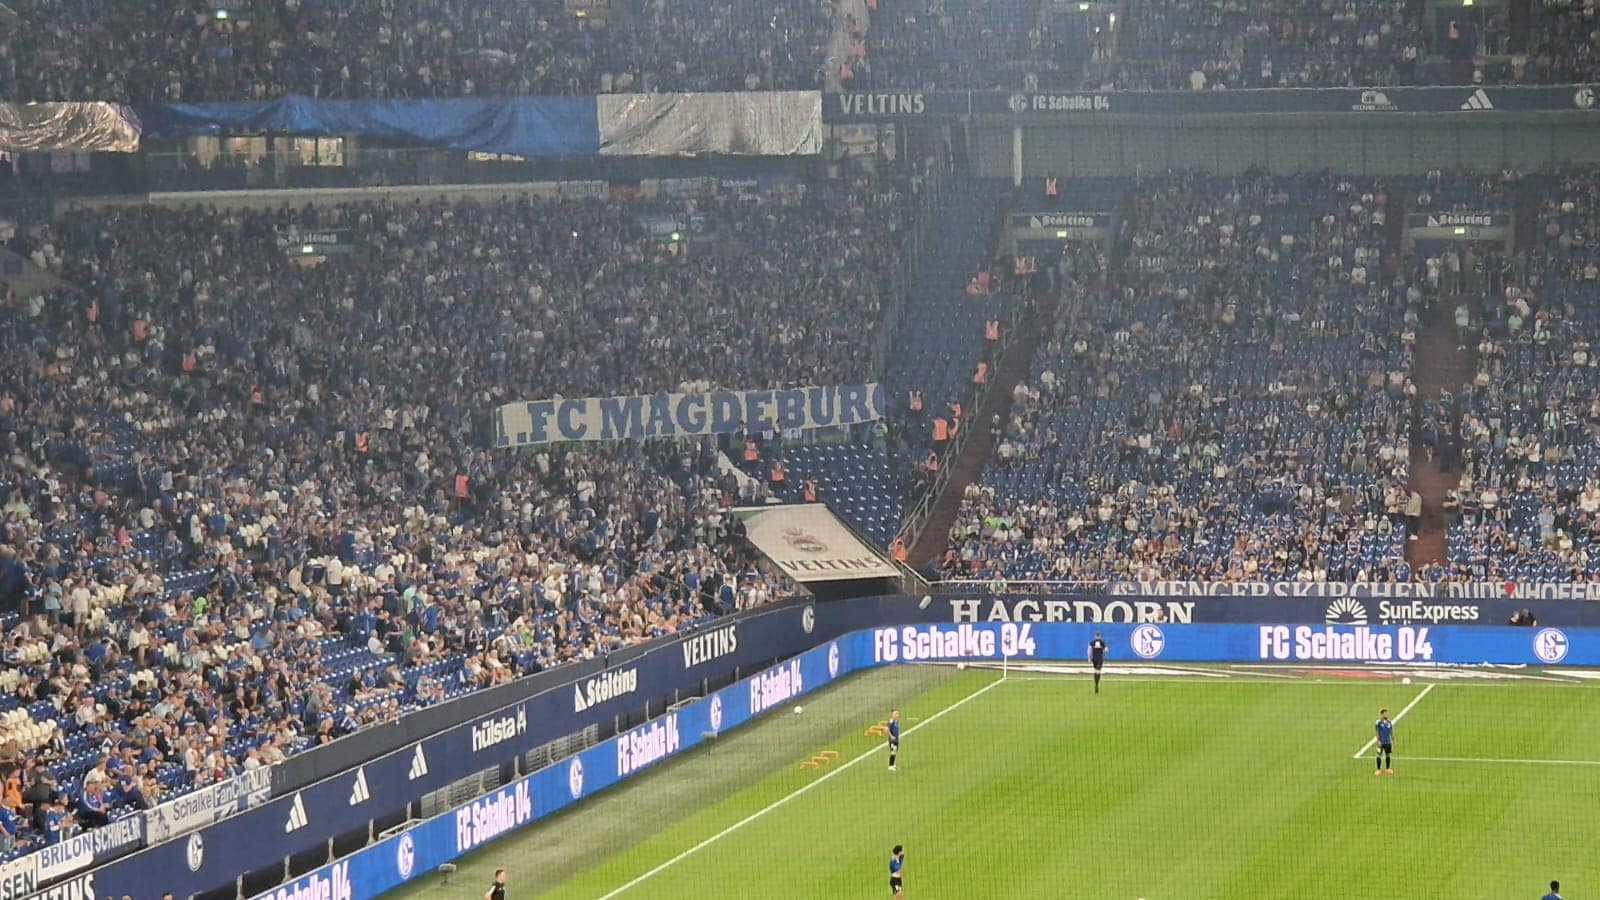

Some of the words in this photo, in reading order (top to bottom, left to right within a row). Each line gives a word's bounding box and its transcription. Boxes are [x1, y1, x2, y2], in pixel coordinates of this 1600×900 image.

[839, 94, 925, 114] VELTINS
[1032, 95, 1047, 110] FC
[1048, 95, 1092, 110] Schalke
[1094, 95, 1110, 110] 04
[781, 557, 884, 572] VELTINS
[949, 600, 1196, 624] HAGEDORN
[1378, 600, 1479, 624] SunExpress
[683, 625, 737, 669] VELTINS
[874, 628, 898, 663] FC
[902, 624, 995, 660] Schalke
[1001, 622, 1036, 657] 04
[1259, 625, 1290, 660] FC
[1295, 626, 1393, 660] Schalke
[1398, 627, 1433, 660] 04
[587, 667, 637, 707] Stölting
[750, 676, 760, 715] FC
[761, 666, 790, 710] Schalke
[791, 658, 802, 696] 04
[472, 716, 516, 752] hülsta
[617, 734, 629, 777] FC
[630, 722, 665, 770] Schalke
[666, 712, 679, 754] 04
[173, 793, 212, 821] Schalke
[457, 805, 471, 853] FC
[472, 789, 514, 845] Schalke
[515, 779, 532, 825] 04
[41, 832, 91, 869] BRILON
